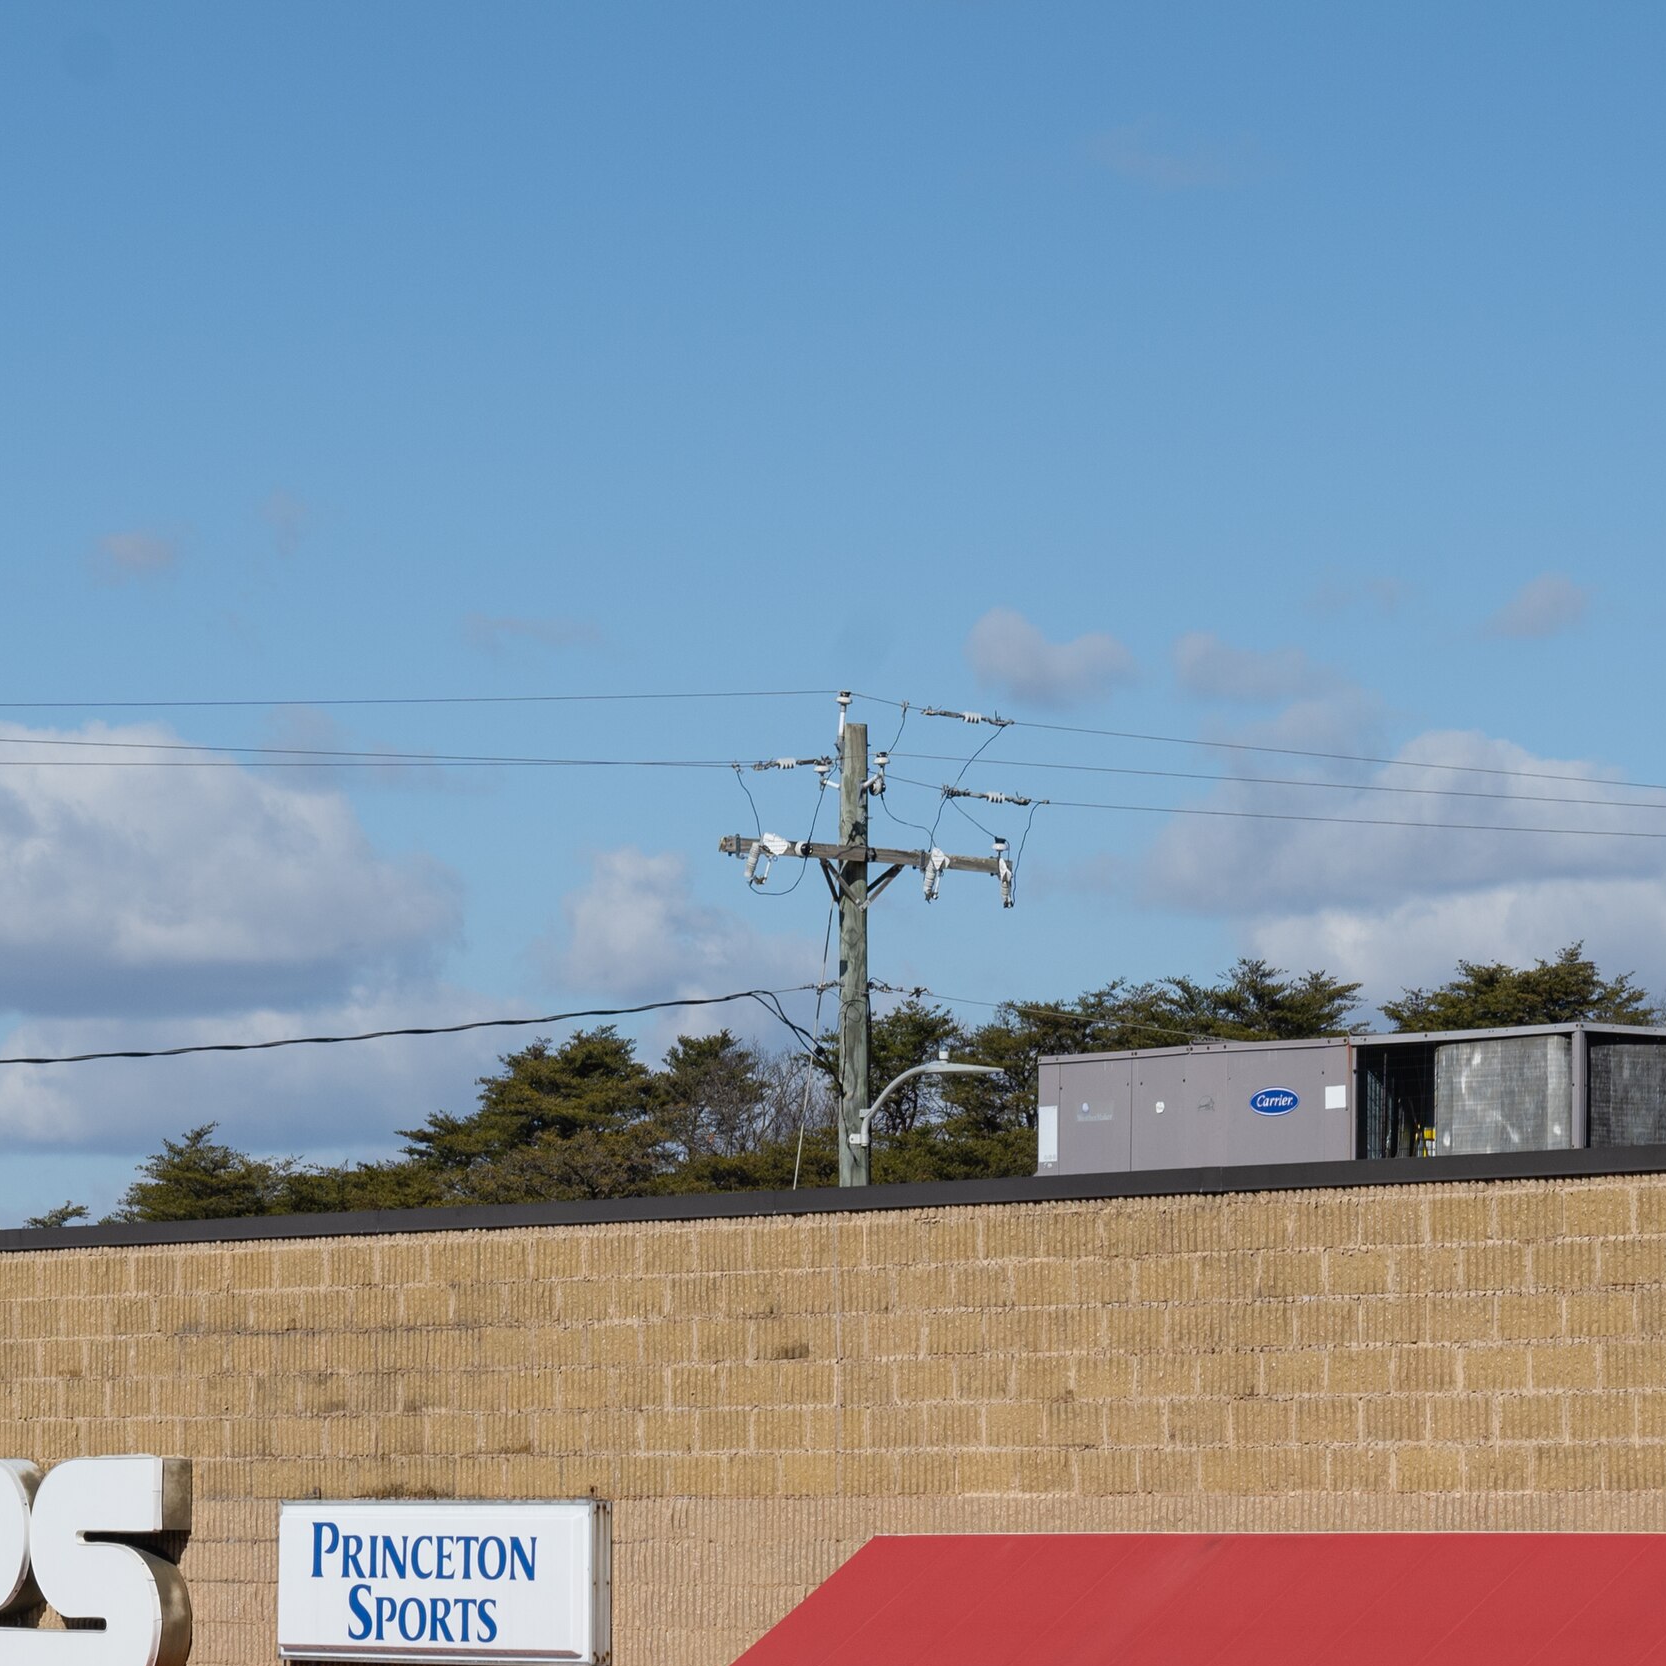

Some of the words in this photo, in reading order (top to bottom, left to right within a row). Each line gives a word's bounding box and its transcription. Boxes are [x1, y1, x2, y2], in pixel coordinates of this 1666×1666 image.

[1255, 1094, 1293, 1108] Carrier
[313, 1521, 538, 1582] PRINCETON
[347, 1584, 499, 1643] SPORTS
